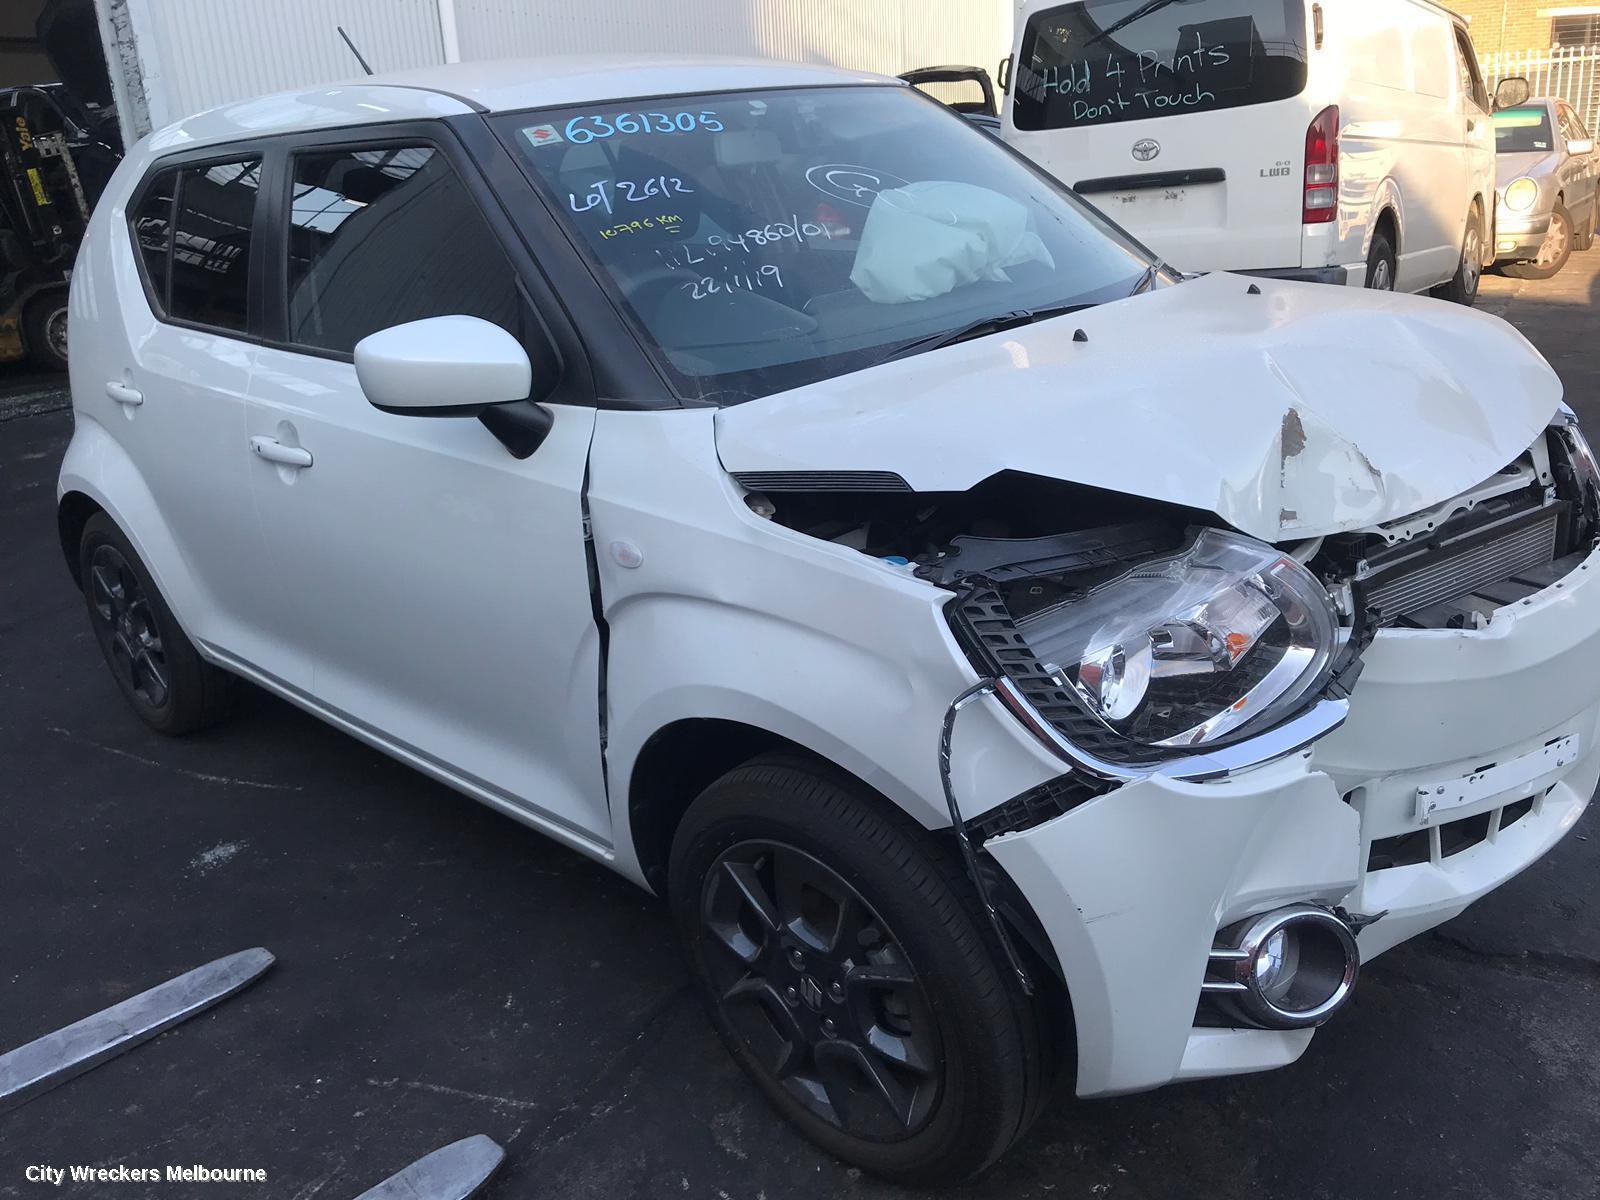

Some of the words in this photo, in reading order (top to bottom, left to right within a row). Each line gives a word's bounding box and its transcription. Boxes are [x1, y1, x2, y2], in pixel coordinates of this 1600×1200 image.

[1042, 60, 1091, 96] Hold
[1106, 53, 1125, 87] 4
[1073, 95, 1130, 120] Don't
[1135, 83, 1215, 109] Touch
[16, 115, 33, 152] Yale
[565, 112, 724, 143] 6361305
[1260, 167, 1290, 178] LWB
